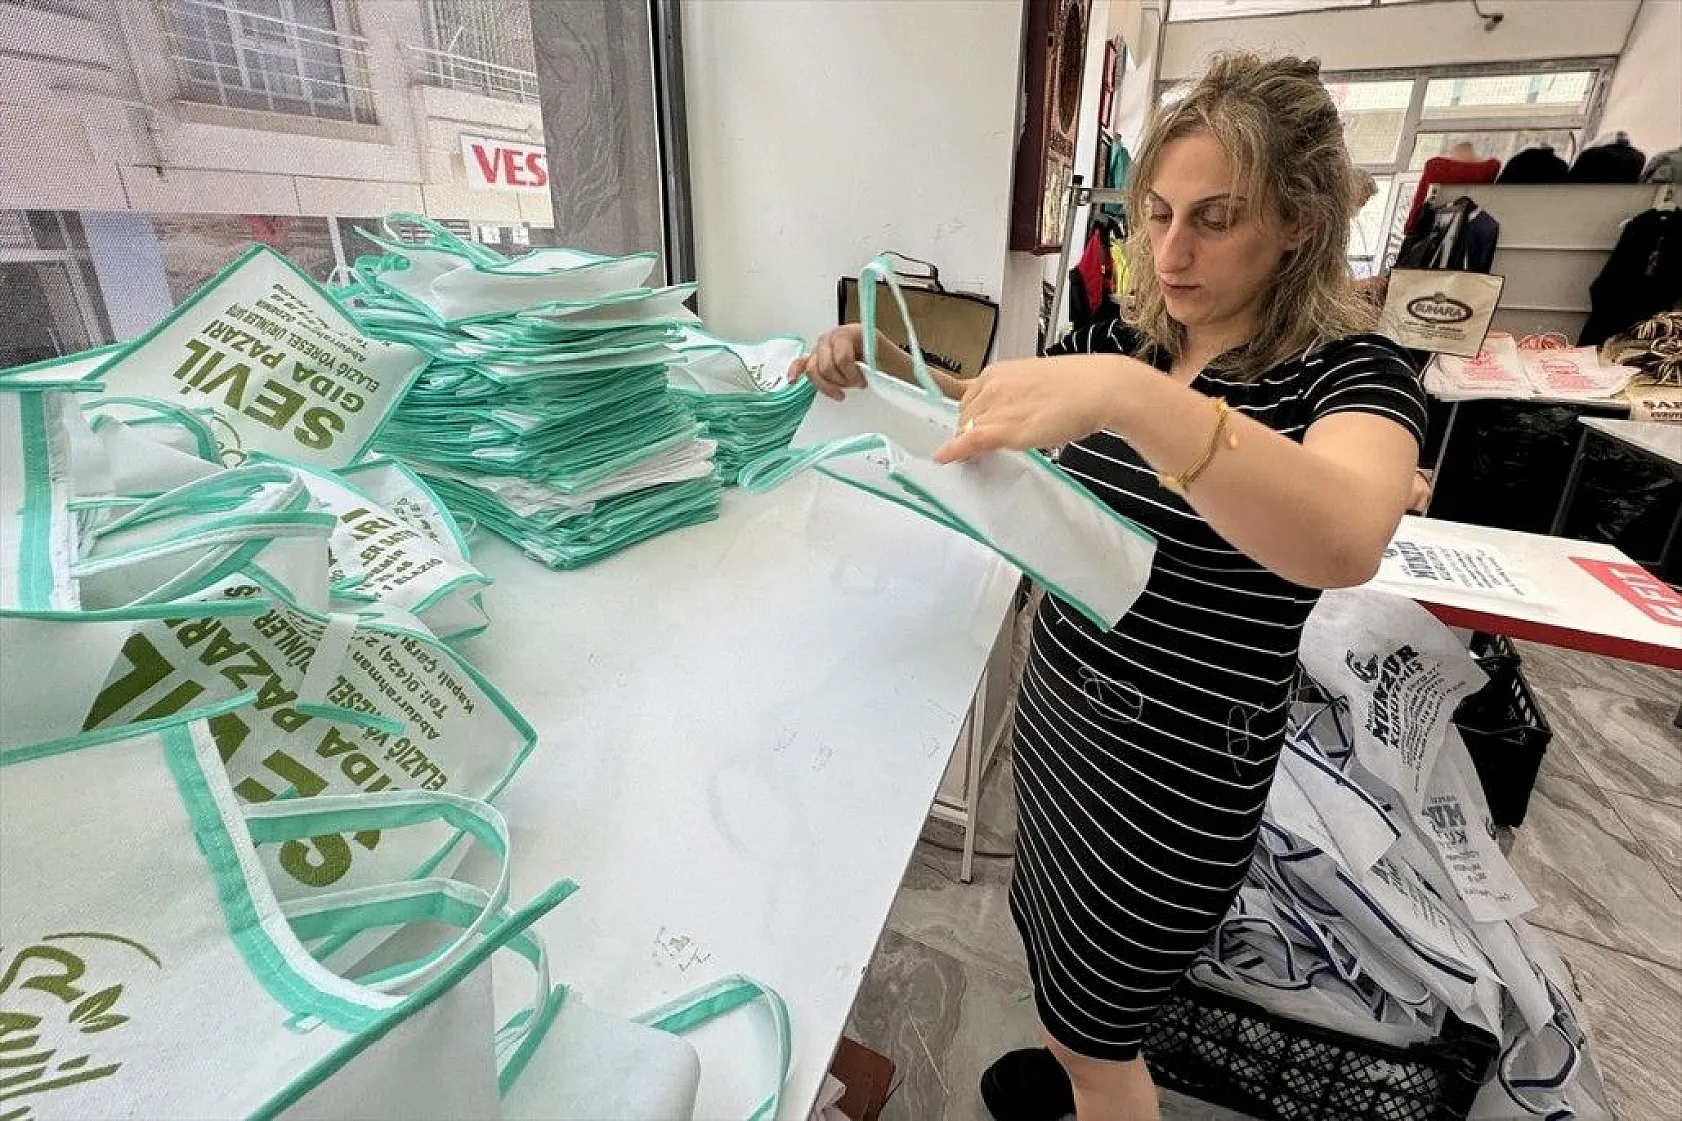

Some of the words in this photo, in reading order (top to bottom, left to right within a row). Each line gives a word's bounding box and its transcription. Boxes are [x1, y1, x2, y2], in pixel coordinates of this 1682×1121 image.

[472, 144, 547, 187] VES
[201, 319, 286, 369] PAZARI
[173, 339, 346, 450] SEVİL
[292, 361, 365, 413] GIDA
[352, 650, 440, 740] Abdurrahman
[315, 726, 394, 792] IDA
